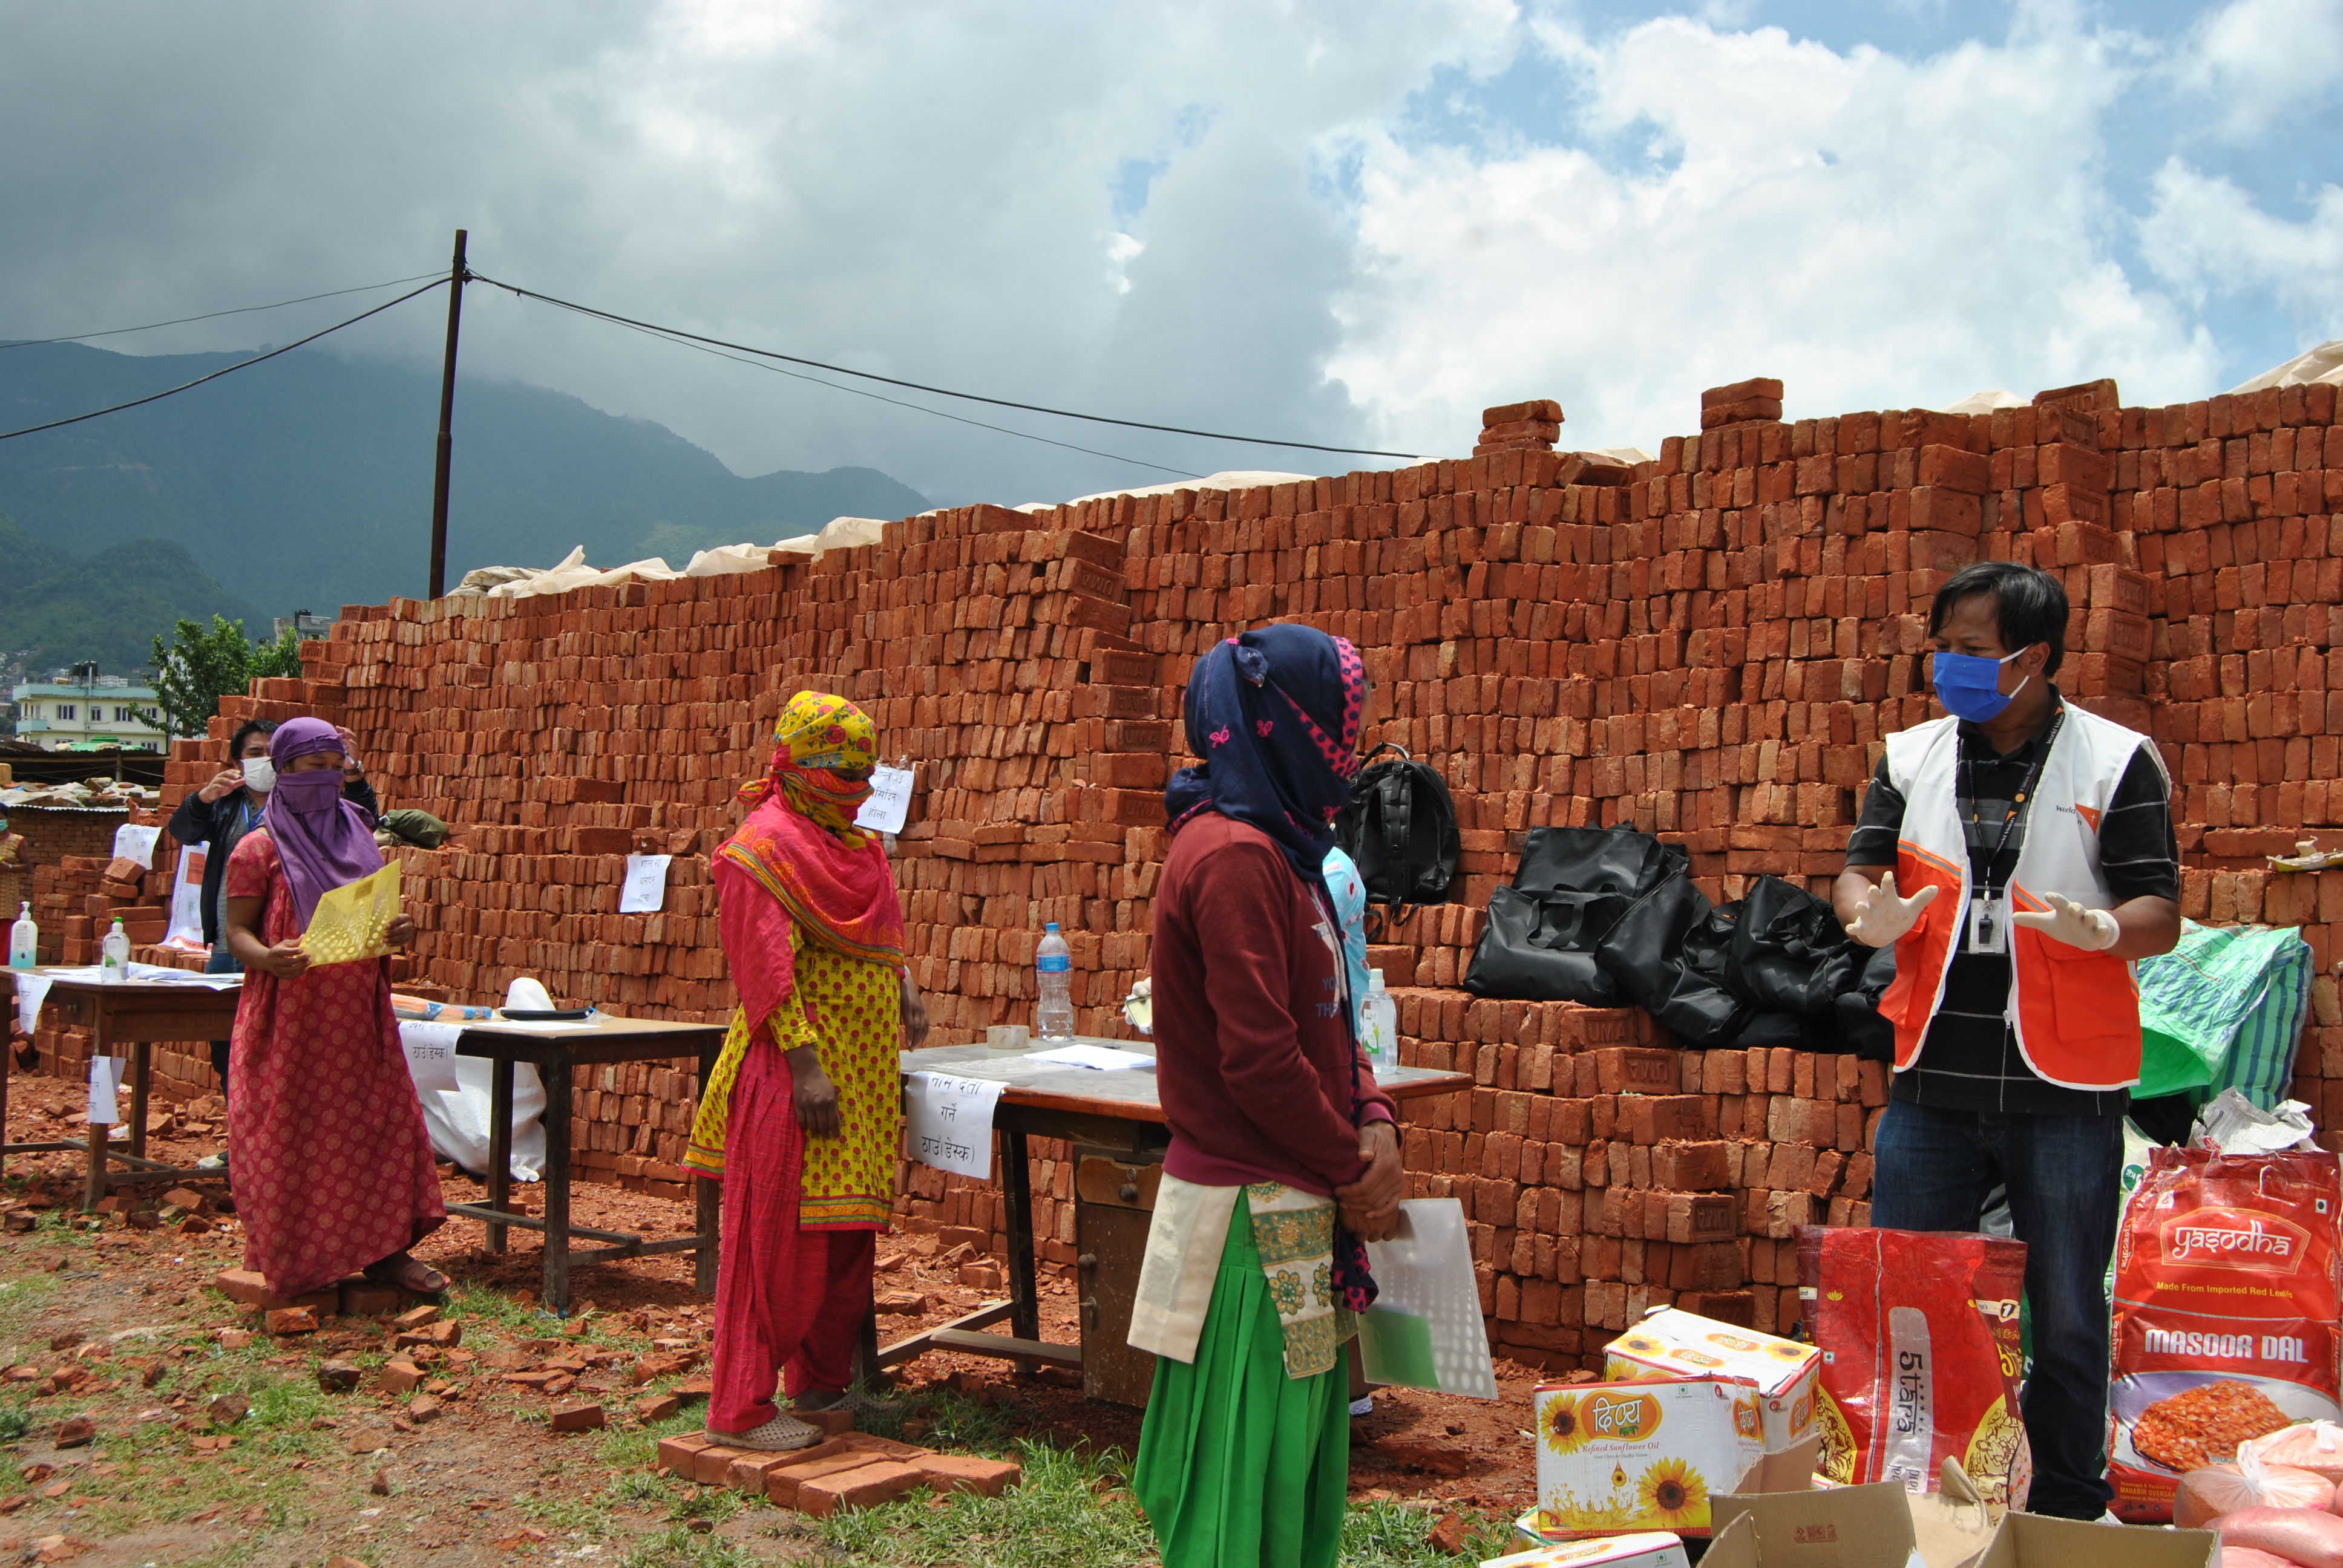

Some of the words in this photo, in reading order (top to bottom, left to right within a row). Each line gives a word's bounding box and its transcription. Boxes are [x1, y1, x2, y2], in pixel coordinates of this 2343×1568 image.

[1083, 574, 1113, 595] UMA
[1126, 730, 1157, 743] UMA
[2046, 728, 2058, 744] World
[2054, 714, 2064, 728] Vision
[868, 806, 886, 820] होला
[1127, 799, 1160, 817] UMA
[2057, 805, 2076, 814] World
[2005, 817, 2016, 834] Vision
[1588, 1022, 1627, 1041] UMA
[1627, 1060, 1668, 1082] UMA
[2157, 1282, 2179, 1290] Made
[2182, 1284, 2204, 1292] From
[2207, 1285, 2247, 1294] Imported
[2250, 1287, 2267, 1296] Red
[2269, 1289, 2293, 1298] Lentils
[2002, 1304, 2012, 1318] 1
[2145, 1329, 2253, 1358] MASOOR
[2261, 1335, 2309, 1363] DAL
[1593, 1396, 1643, 1434] दिव्य
[1583, 1444, 1607, 1454] Refined
[1609, 1442, 1645, 1452] Sunflower
